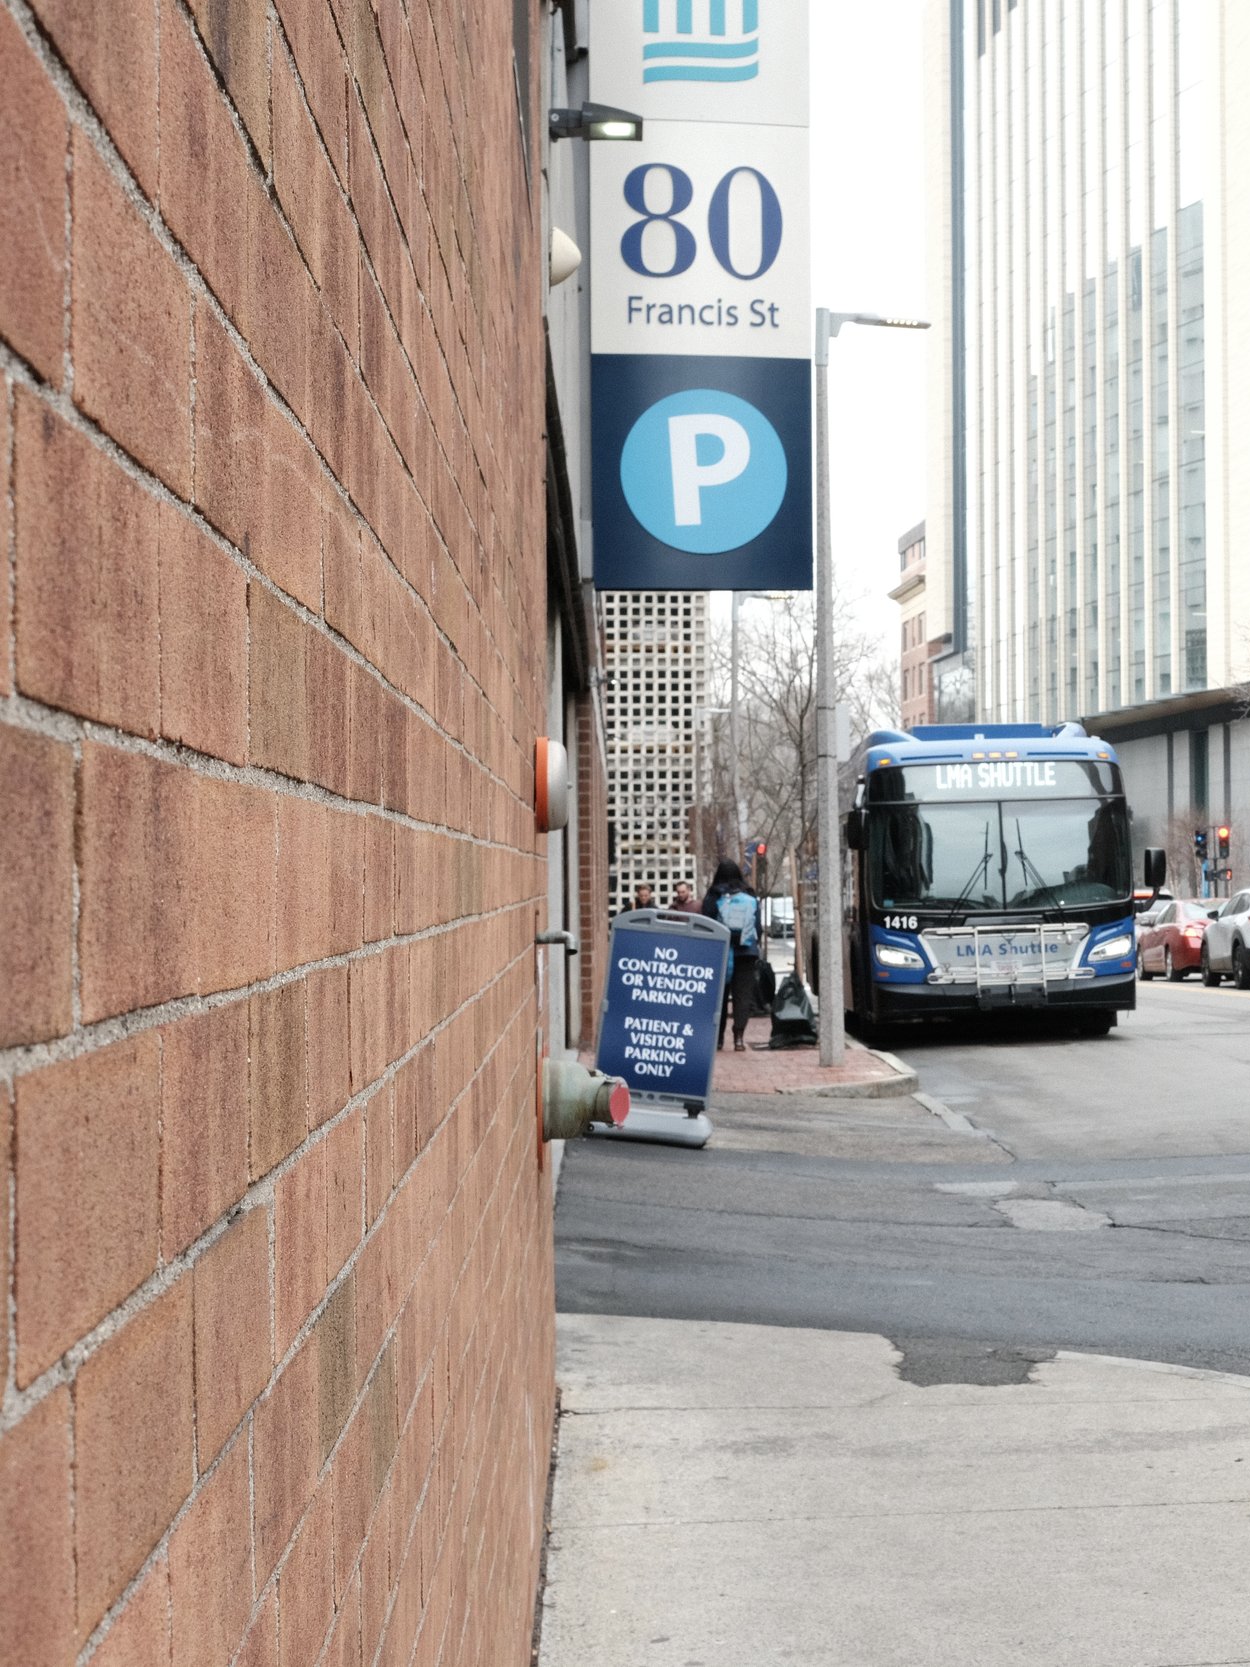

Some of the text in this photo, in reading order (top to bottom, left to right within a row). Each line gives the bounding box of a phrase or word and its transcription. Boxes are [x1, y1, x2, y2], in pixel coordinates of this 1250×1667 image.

[620, 163, 783, 281] 80
[627, 296, 780, 329] Francis St
[668, 413, 751, 526] P
[936, 762, 1056, 789] LMA SHUTTLE
[883, 915, 918, 930] 1416
[654, 947, 678, 961] NO
[957, 944, 993, 957] LMA
[618, 957, 714, 980] CONTRACTOR
[622, 972, 707, 994] OR VENDOR
[632, 988, 693, 1007] PARKING
[624, 1017, 694, 1037] PATIENT &
[630, 1032, 685, 1050] VISITOR
[624, 1046, 686, 1065] PARKING
[634, 1062, 674, 1078] ONLY
